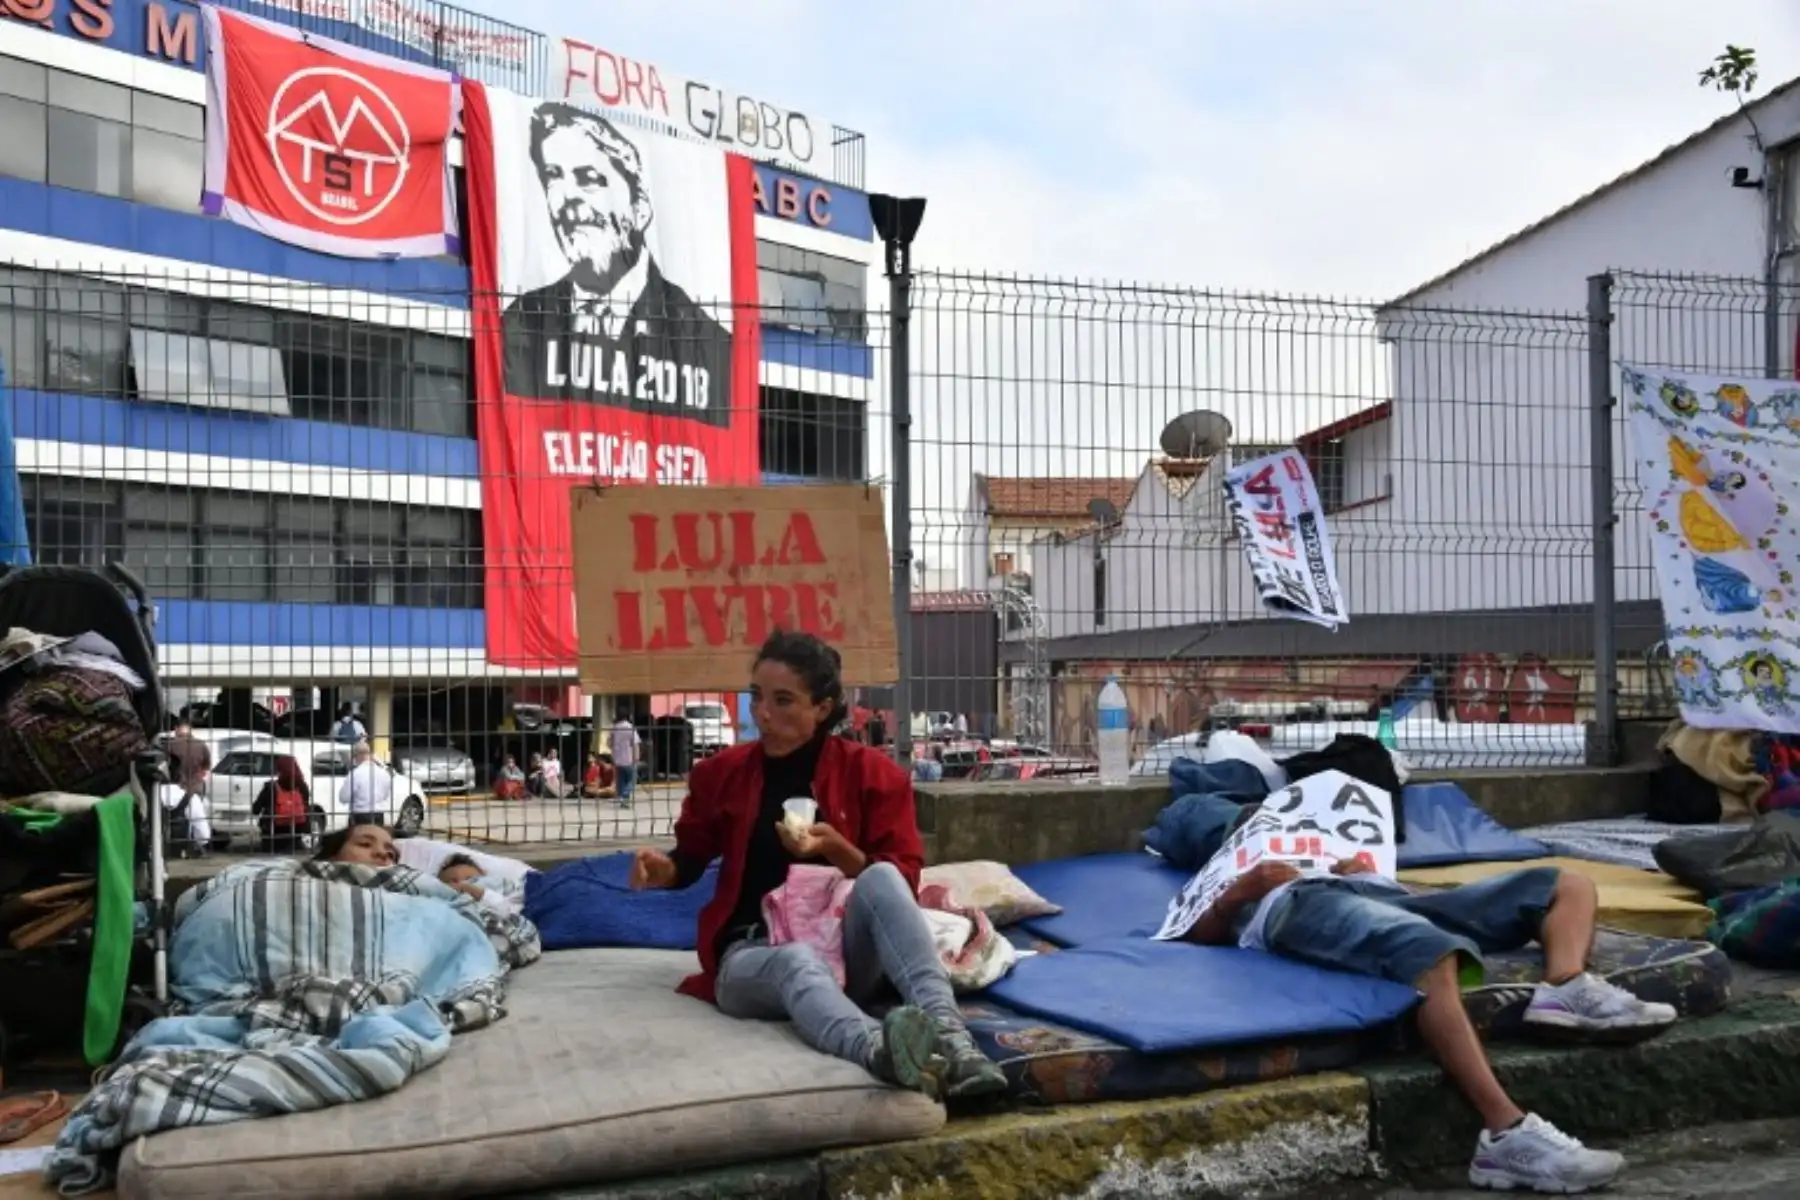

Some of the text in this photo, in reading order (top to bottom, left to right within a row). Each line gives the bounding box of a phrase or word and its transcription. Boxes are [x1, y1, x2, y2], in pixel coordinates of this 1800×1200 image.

[561, 37, 814, 163] FORA GLOBO
[752, 172, 833, 228] ABC
[546, 340, 710, 410] LULA 2018
[543, 429, 648, 485] ELEIÇÃO
[629, 510, 827, 572] LULA
[614, 581, 847, 650] LIVRE
